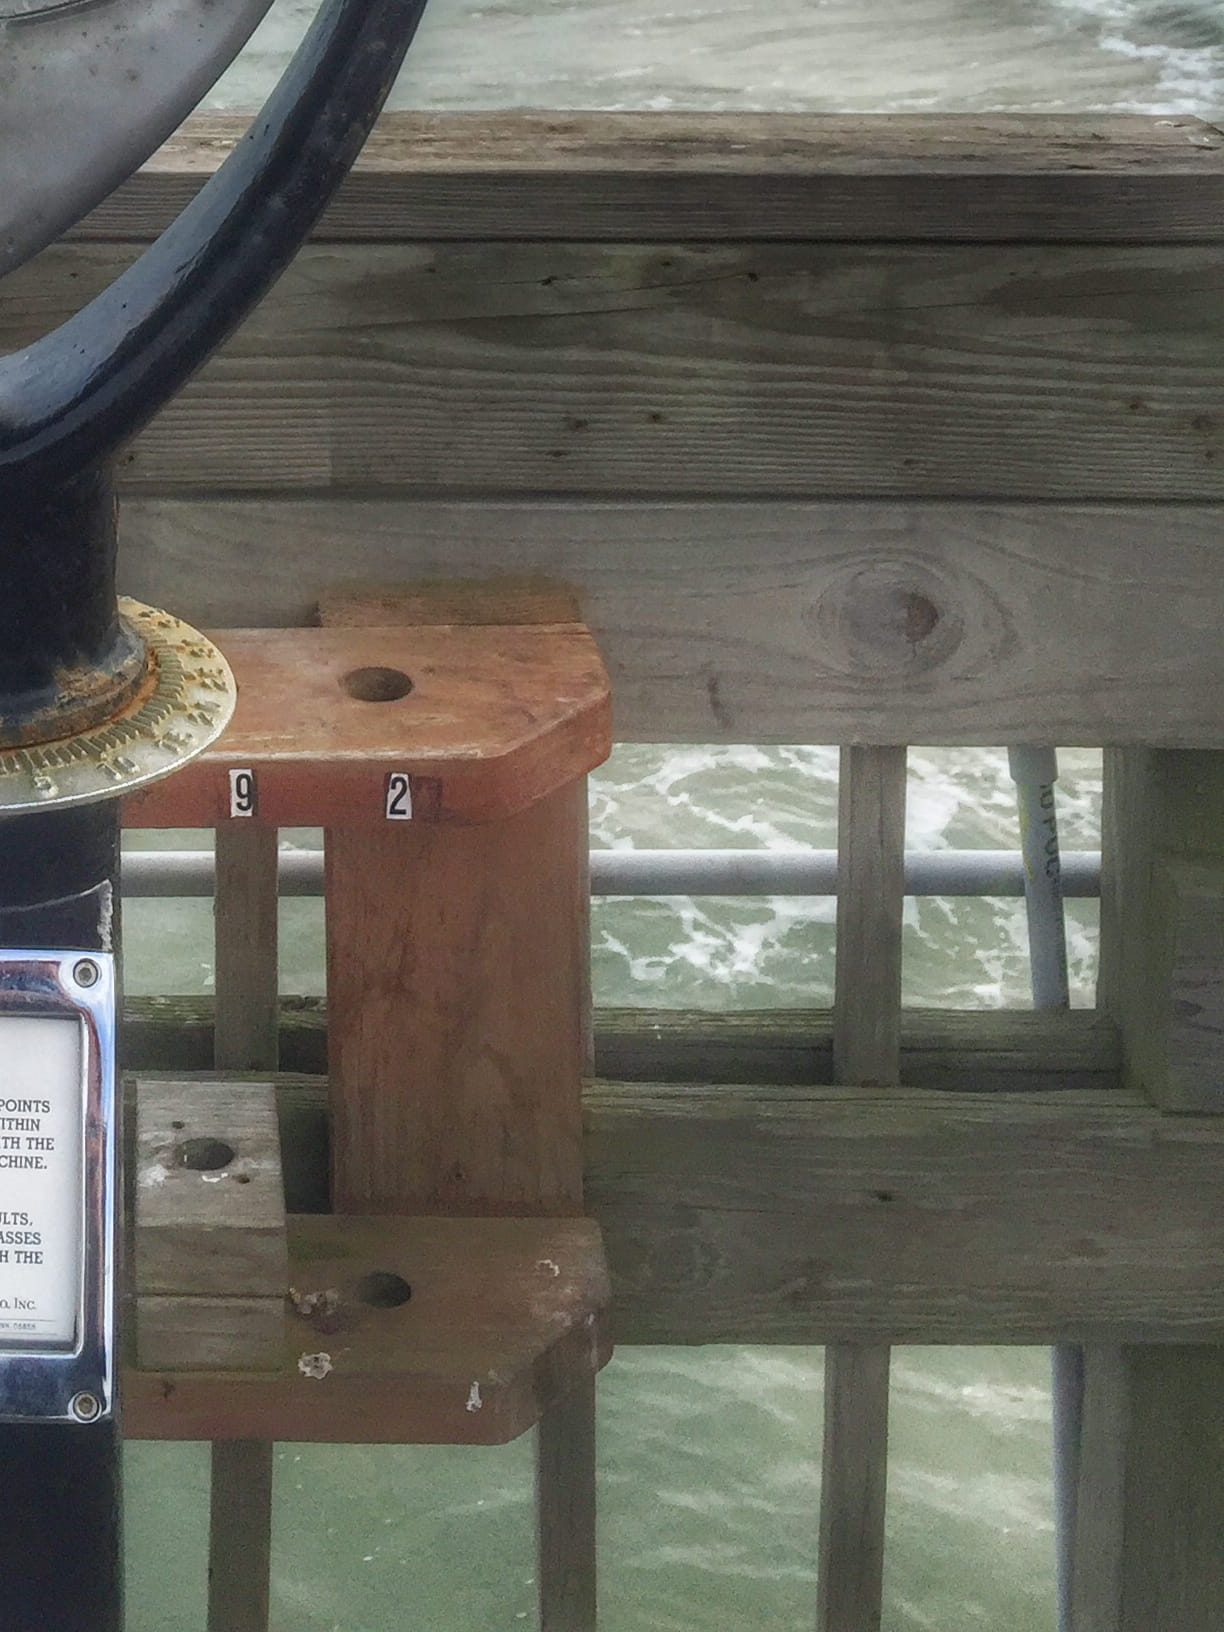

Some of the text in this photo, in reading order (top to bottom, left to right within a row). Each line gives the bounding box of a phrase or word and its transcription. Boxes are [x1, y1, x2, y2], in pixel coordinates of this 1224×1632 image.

[236, 774, 252, 810] 9
[390, 776, 408, 815] 2
[26, 1137, 54, 1150] THE
[14, 1251, 43, 1264] THE
